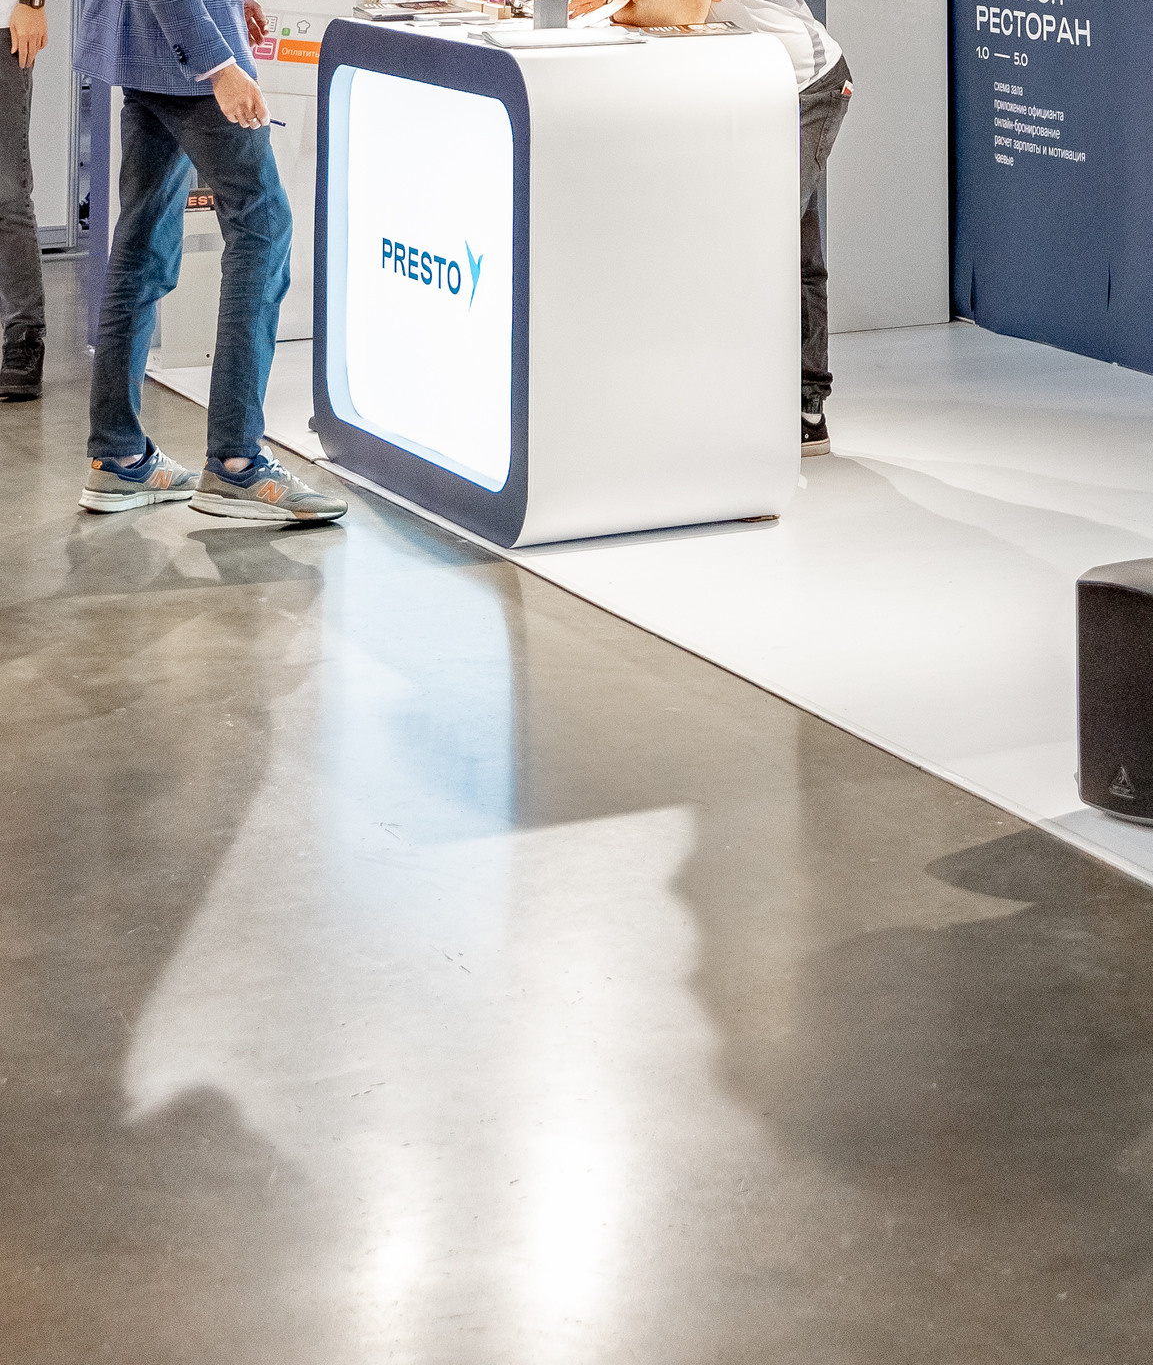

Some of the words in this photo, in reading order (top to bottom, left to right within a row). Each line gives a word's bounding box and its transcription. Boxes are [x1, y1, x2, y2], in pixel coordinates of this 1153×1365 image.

[976, 5, 1091, 47] РЕСТОРАН
[281, 46, 320, 59] Оплатить
[975, 45, 990, 60] 1.0
[1013, 52, 1028, 66] 5.0
[994, 81, 1010, 93] схема
[1010, 85, 1024, 97] зала
[994, 99, 1027, 115] приложение
[1028, 105, 1064, 121] официанта
[994, 117, 1060, 139] онлайн-бронирование
[994, 135, 1012, 147] расчет
[1013, 139, 1042, 155] зарплаты
[1042, 145, 1048, 155] и
[1048, 147, 1086, 163] мотивация
[994, 153, 1014, 167] чаевые
[382, 237, 461, 295] PRESTO
